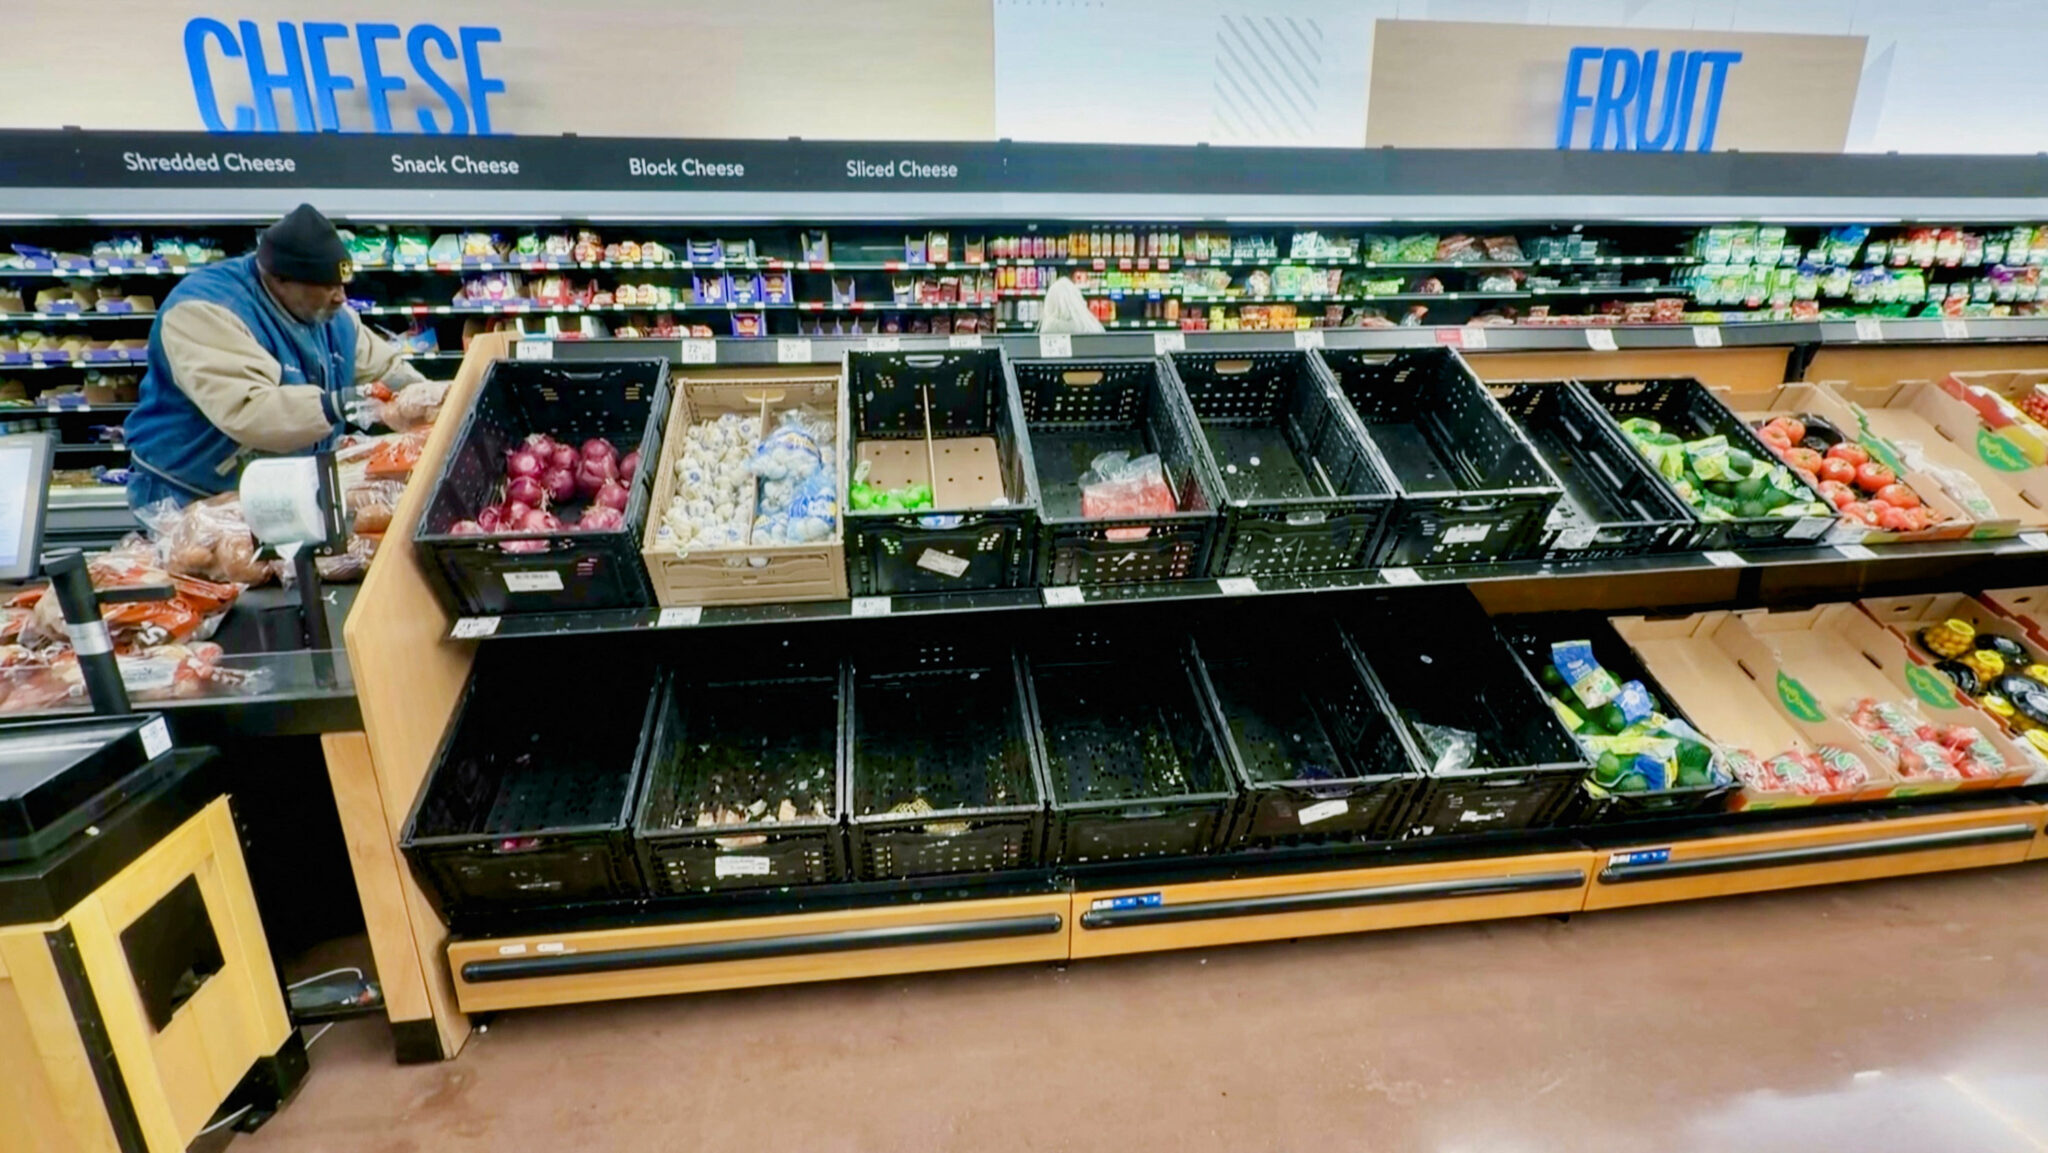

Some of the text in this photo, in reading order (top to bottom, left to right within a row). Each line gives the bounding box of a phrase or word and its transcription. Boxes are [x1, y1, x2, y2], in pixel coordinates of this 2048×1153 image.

[183, 17, 507, 136] CHEESE
[1556, 46, 1743, 153] FRUIT
[123, 151, 296, 174] Shredded Cheese
[391, 153, 520, 176] Snack Cheese
[628, 157, 745, 178] Block Cheese
[846, 159, 959, 179] Sliced Cheese
